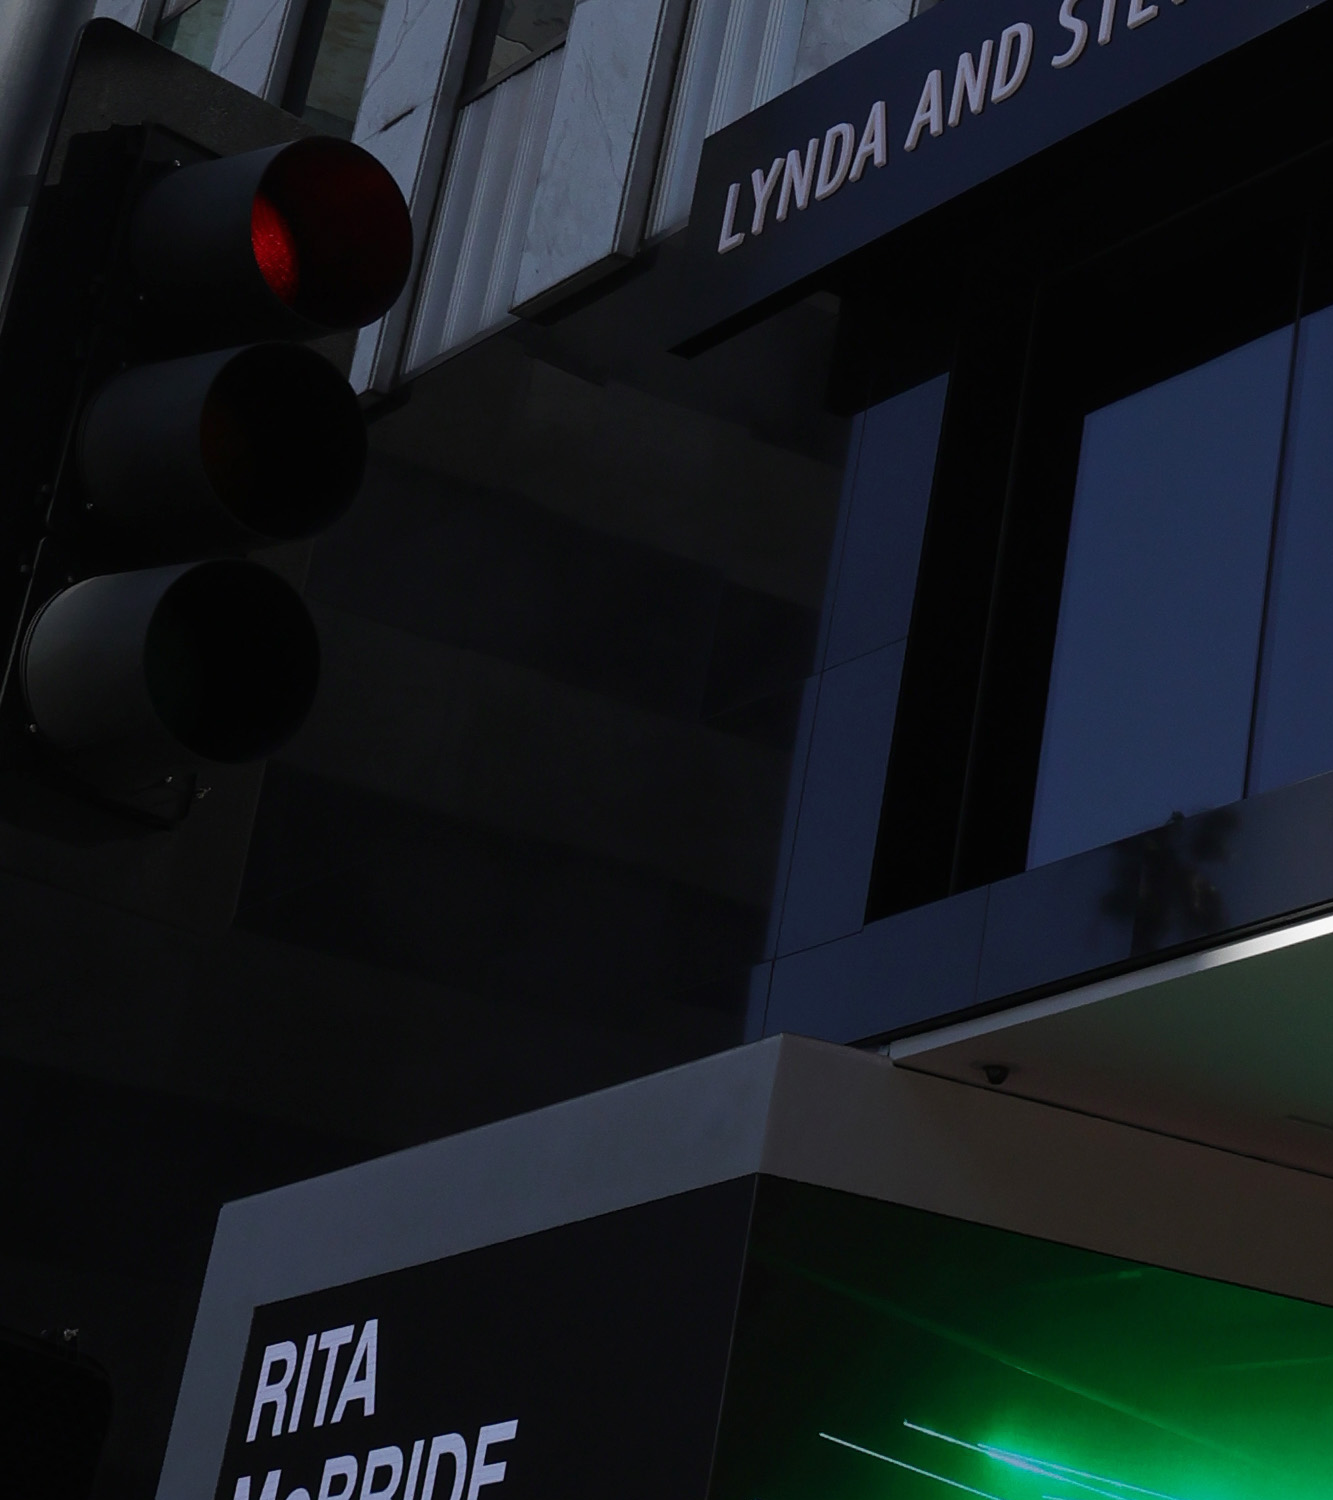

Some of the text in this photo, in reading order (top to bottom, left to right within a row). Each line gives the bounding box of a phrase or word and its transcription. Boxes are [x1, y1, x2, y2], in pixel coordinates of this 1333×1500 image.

[717, 100, 887, 255] LYNDA
[904, 21, 1033, 152] AND
[245, 1318, 379, 1443] RITA
